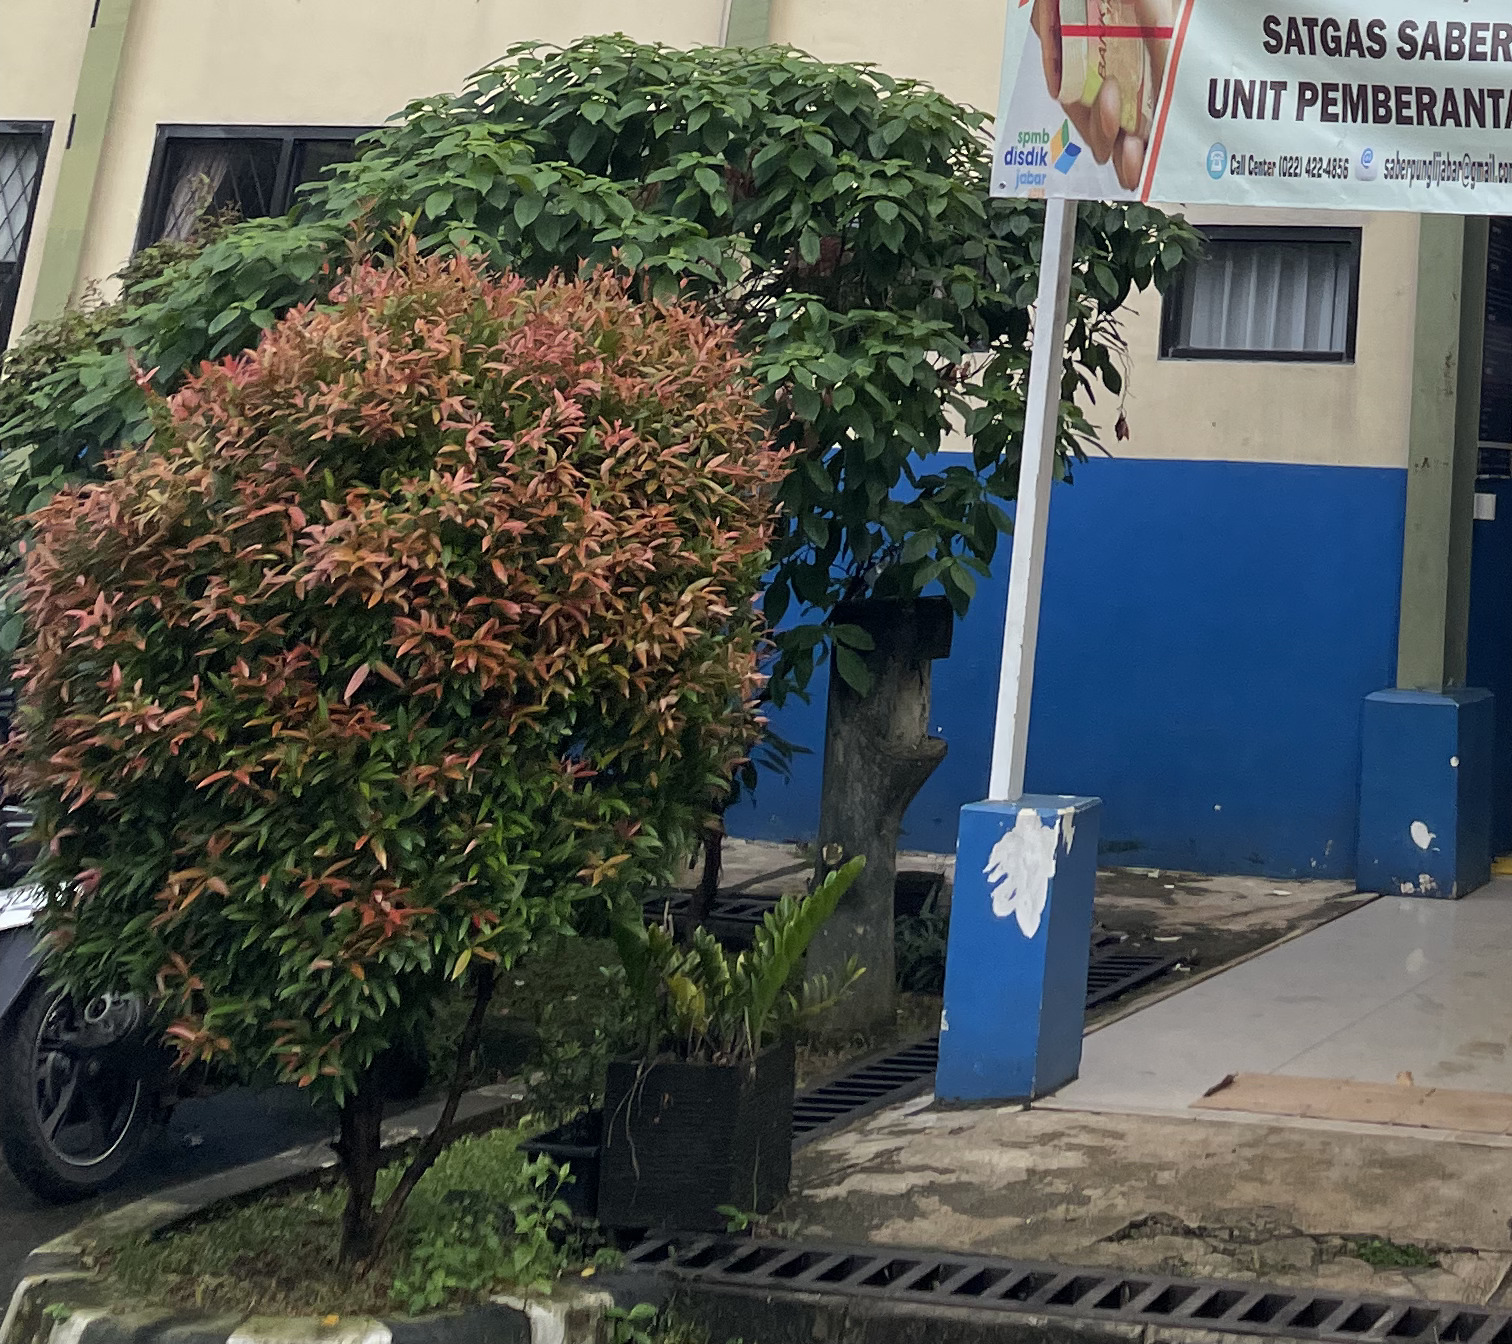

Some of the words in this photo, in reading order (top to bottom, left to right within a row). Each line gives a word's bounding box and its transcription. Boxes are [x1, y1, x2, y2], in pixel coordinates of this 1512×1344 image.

[1262, 14, 1388, 60] SATGAS
[1207, 77, 1288, 121] UNIT
[1017, 128, 1050, 148] spmb
[1004, 145, 1049, 167] disdik
[1230, 153, 1246, 176] Call
[1248, 153, 1276, 177] Center
[1278, 155, 1303, 179] (022)
[1305, 156, 1349, 180] 422-4856
[1014, 169, 1047, 191] jabar
